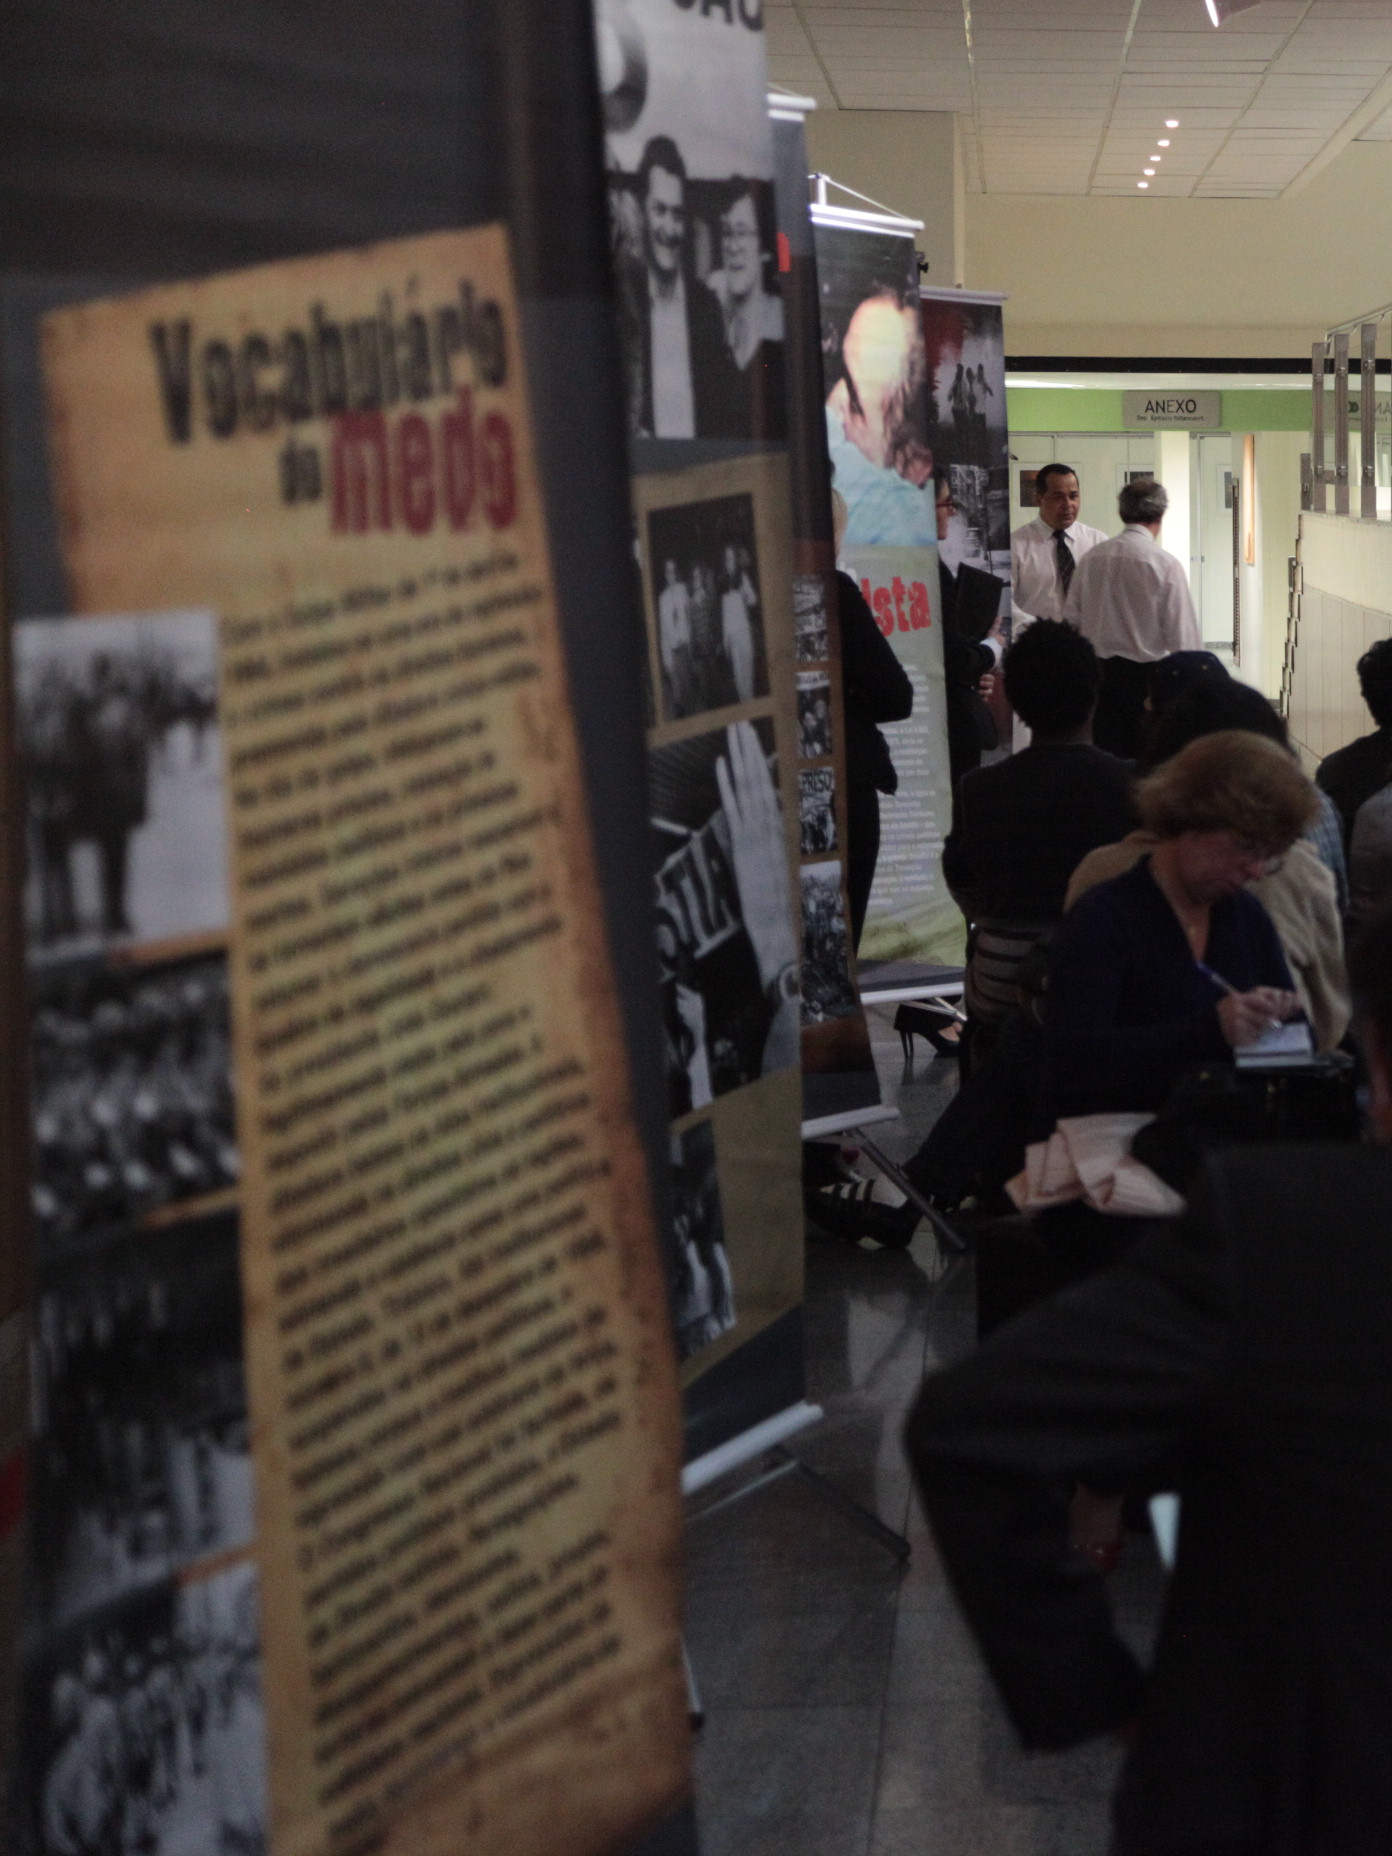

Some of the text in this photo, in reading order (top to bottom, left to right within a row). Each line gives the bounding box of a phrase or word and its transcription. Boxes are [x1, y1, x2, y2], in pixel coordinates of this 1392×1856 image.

[149, 272, 508, 447] Vocabulário
[1144, 399, 1197, 413] ANEXO
[279, 383, 519, 537] do medo
